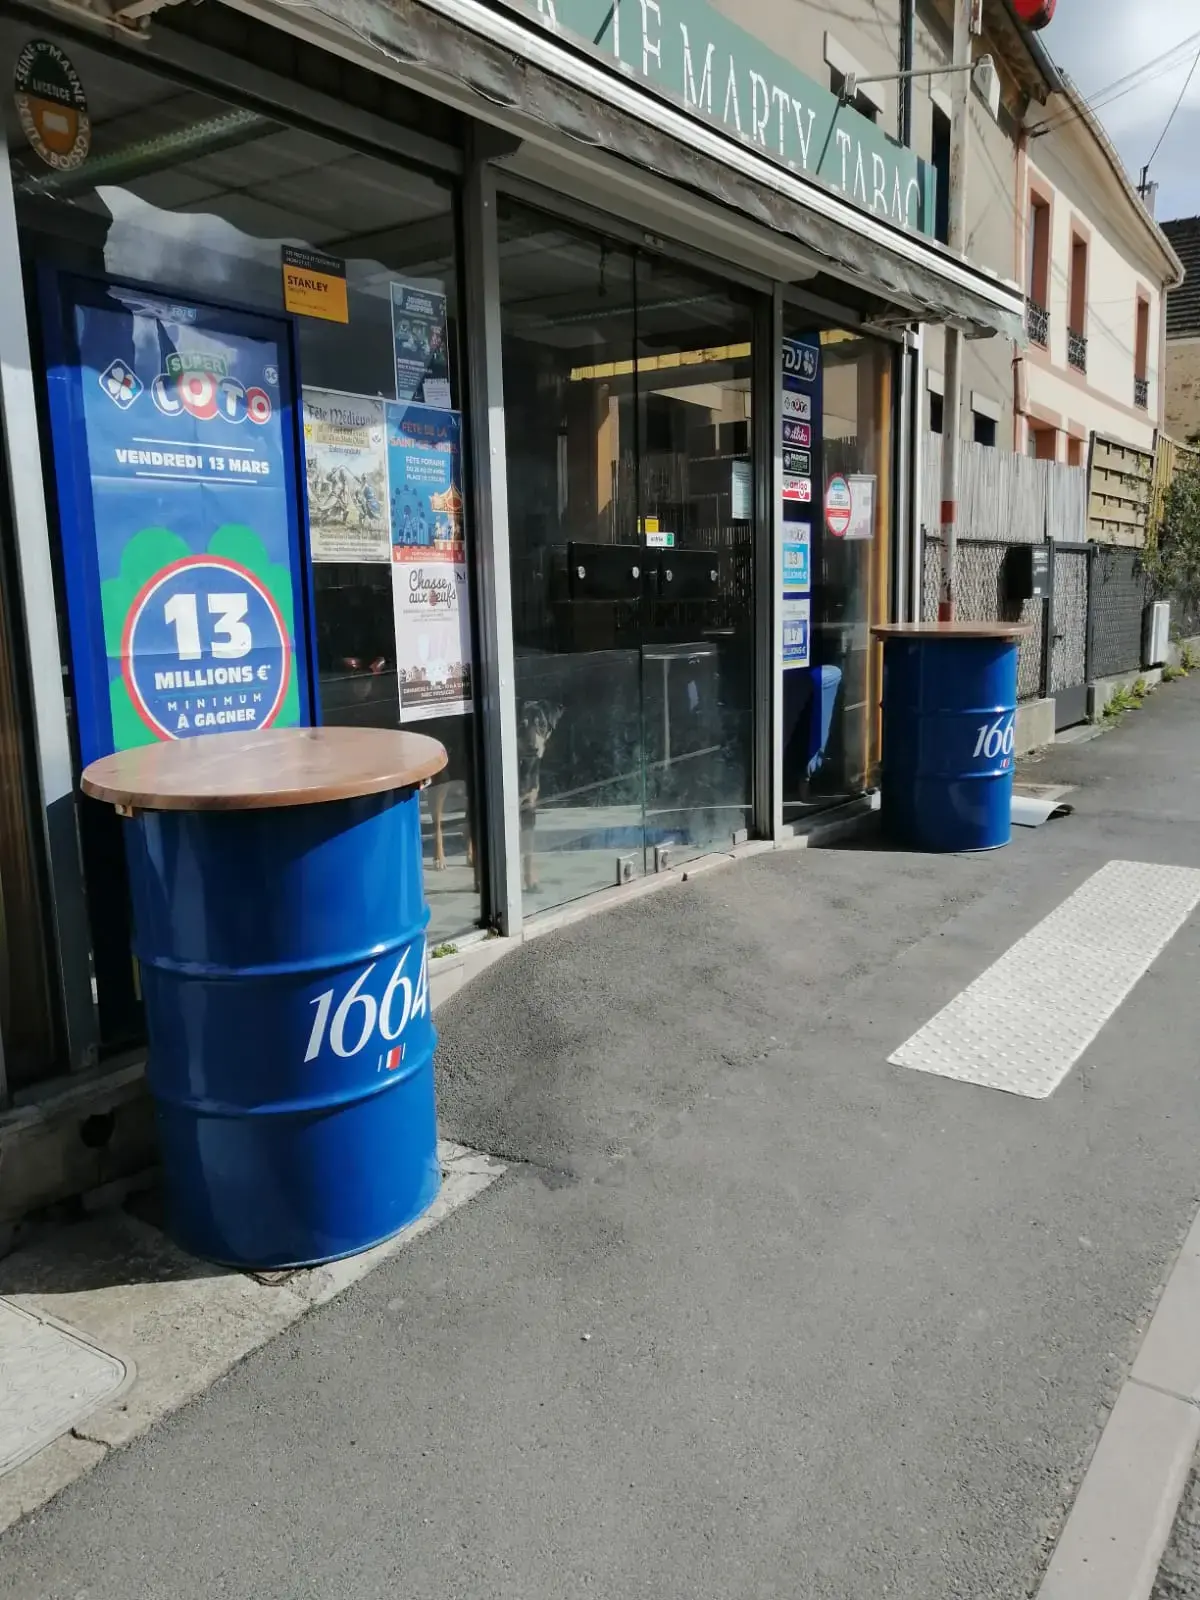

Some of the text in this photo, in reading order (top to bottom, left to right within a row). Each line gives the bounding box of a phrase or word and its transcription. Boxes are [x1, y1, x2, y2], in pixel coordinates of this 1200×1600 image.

[49, 45, 86, 103] MARNE
[32, 78, 70, 101] LICENCE
[680, 22, 816, 170] MARTY
[835, 128, 921, 228] TABAC
[287, 275, 328, 293] STANLEY
[170, 356, 224, 373] SUPER
[154, 371, 271, 424] LOTO
[115, 449, 270, 474] VENDREDI 13 MARS
[789, 479, 808, 497] amigo
[409, 569, 448, 592] Chasse
[408, 592, 428, 604] aux
[163, 593, 252, 660] 13
[154, 666, 253, 690] MILLIONS
[167, 692, 263, 712] MINIMUM
[177, 708, 256, 729] À GAGNER
[972, 711, 1015, 758] 166
[304, 939, 428, 1063] 1664
